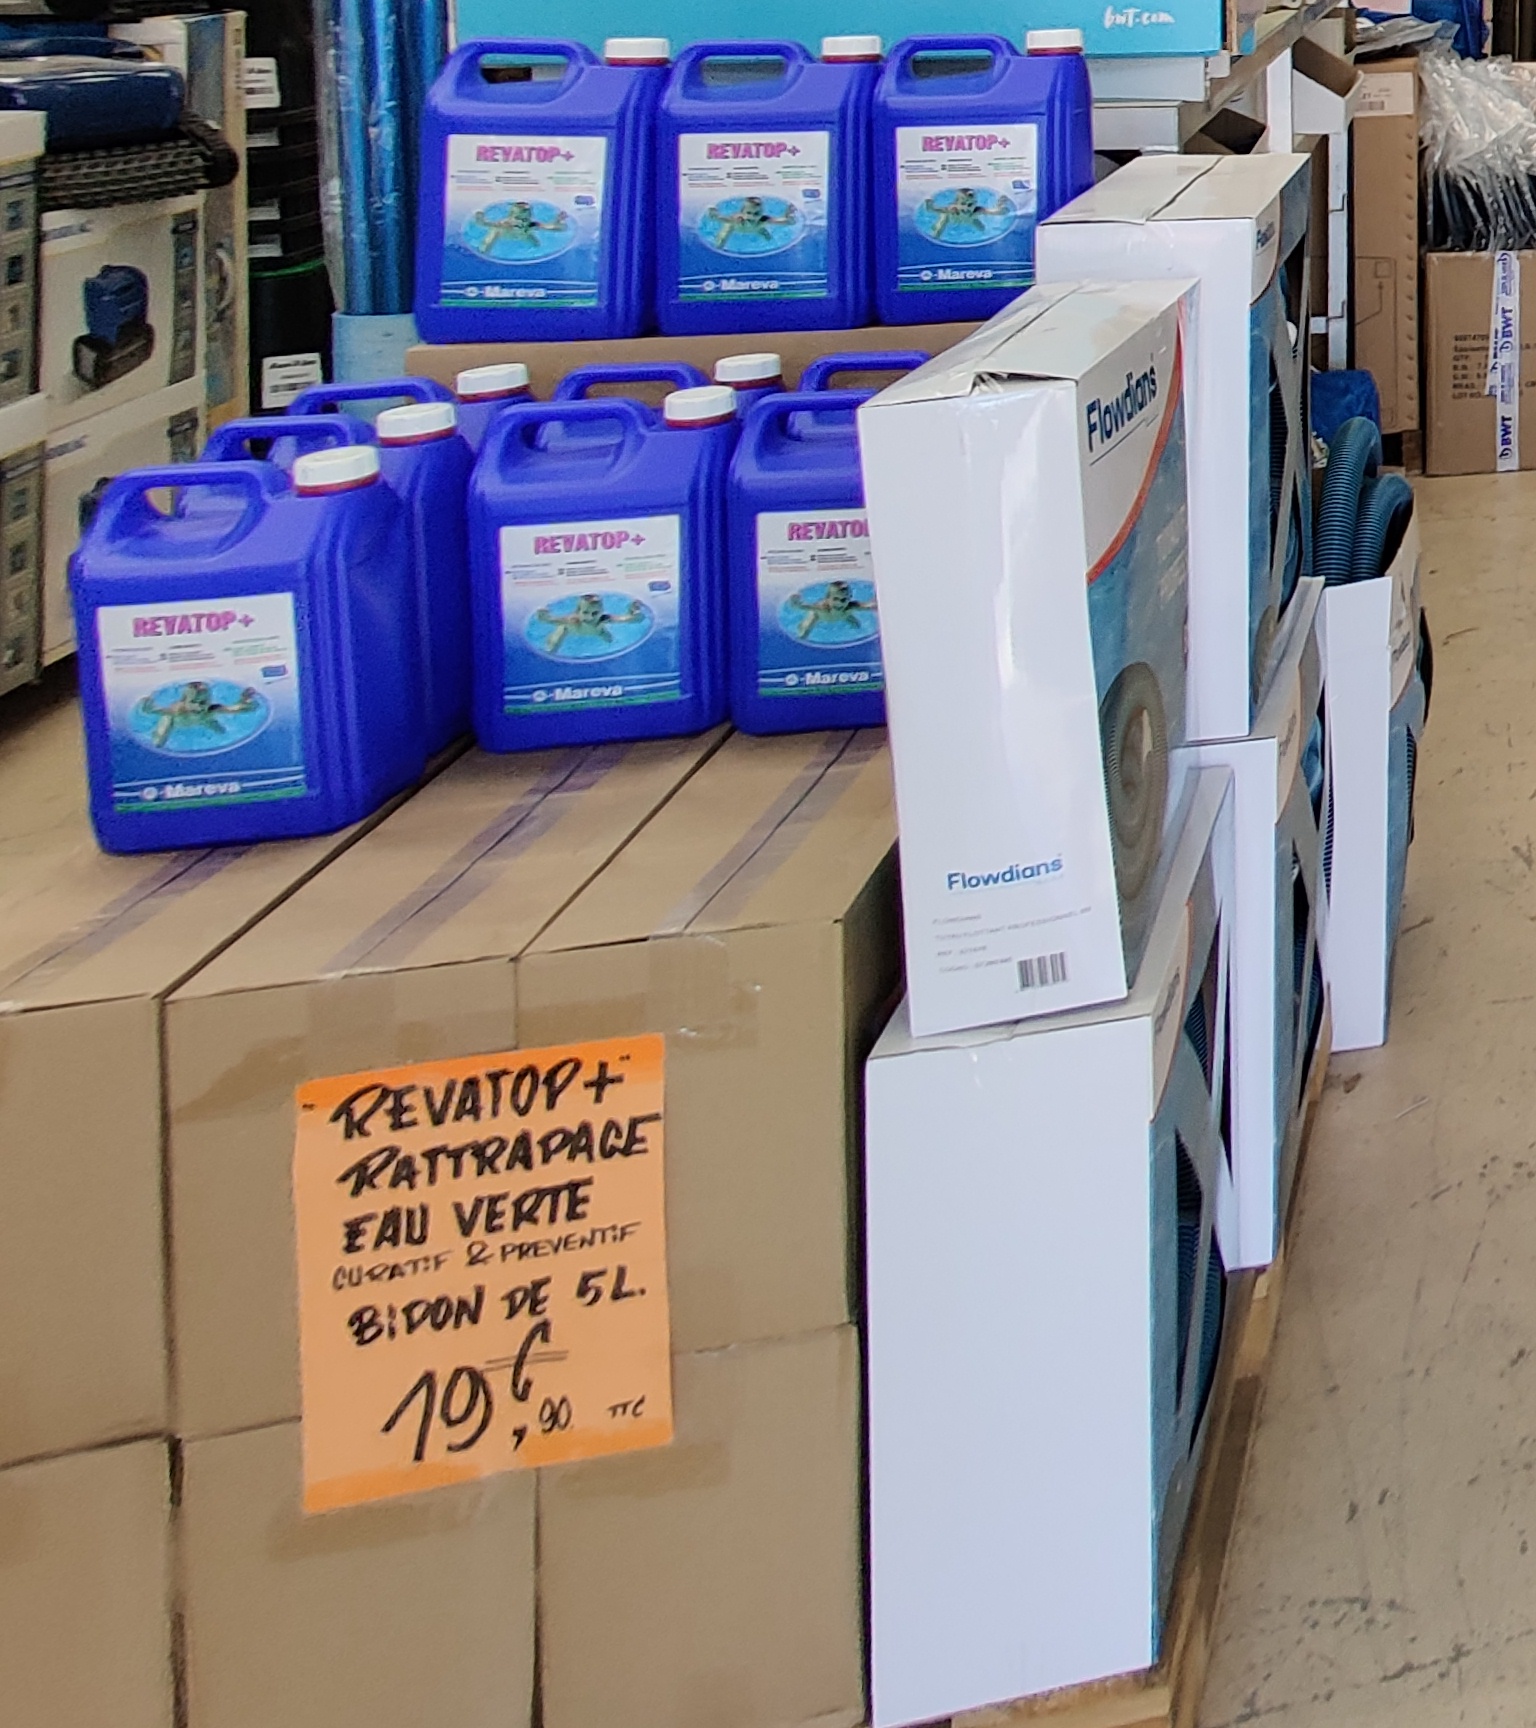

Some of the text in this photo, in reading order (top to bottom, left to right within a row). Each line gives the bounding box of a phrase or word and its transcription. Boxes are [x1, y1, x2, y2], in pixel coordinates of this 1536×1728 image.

[1103, 5, 1176, 29] bwt.com
[720, 279, 779, 292] Mareva
[937, 268, 992, 281] Mareva
[483, 285, 548, 298] Mareva
[1501, 306, 1514, 339] BWT
[1085, 363, 1158, 453] Flowdians
[1500, 415, 1513, 448] BWT
[805, 670, 870, 686] Mareva
[554, 683, 624, 702] Mareva
[163, 781, 241, 800] Mareva
[946, 855, 1064, 891] Flowdians
[336, 1112, 663, 1198] RATTRAPAGE
[342, 1176, 594, 1254] EAU VERTE
[465, 1240, 493, 1267] &
[501, 1275, 553, 1321] DE
